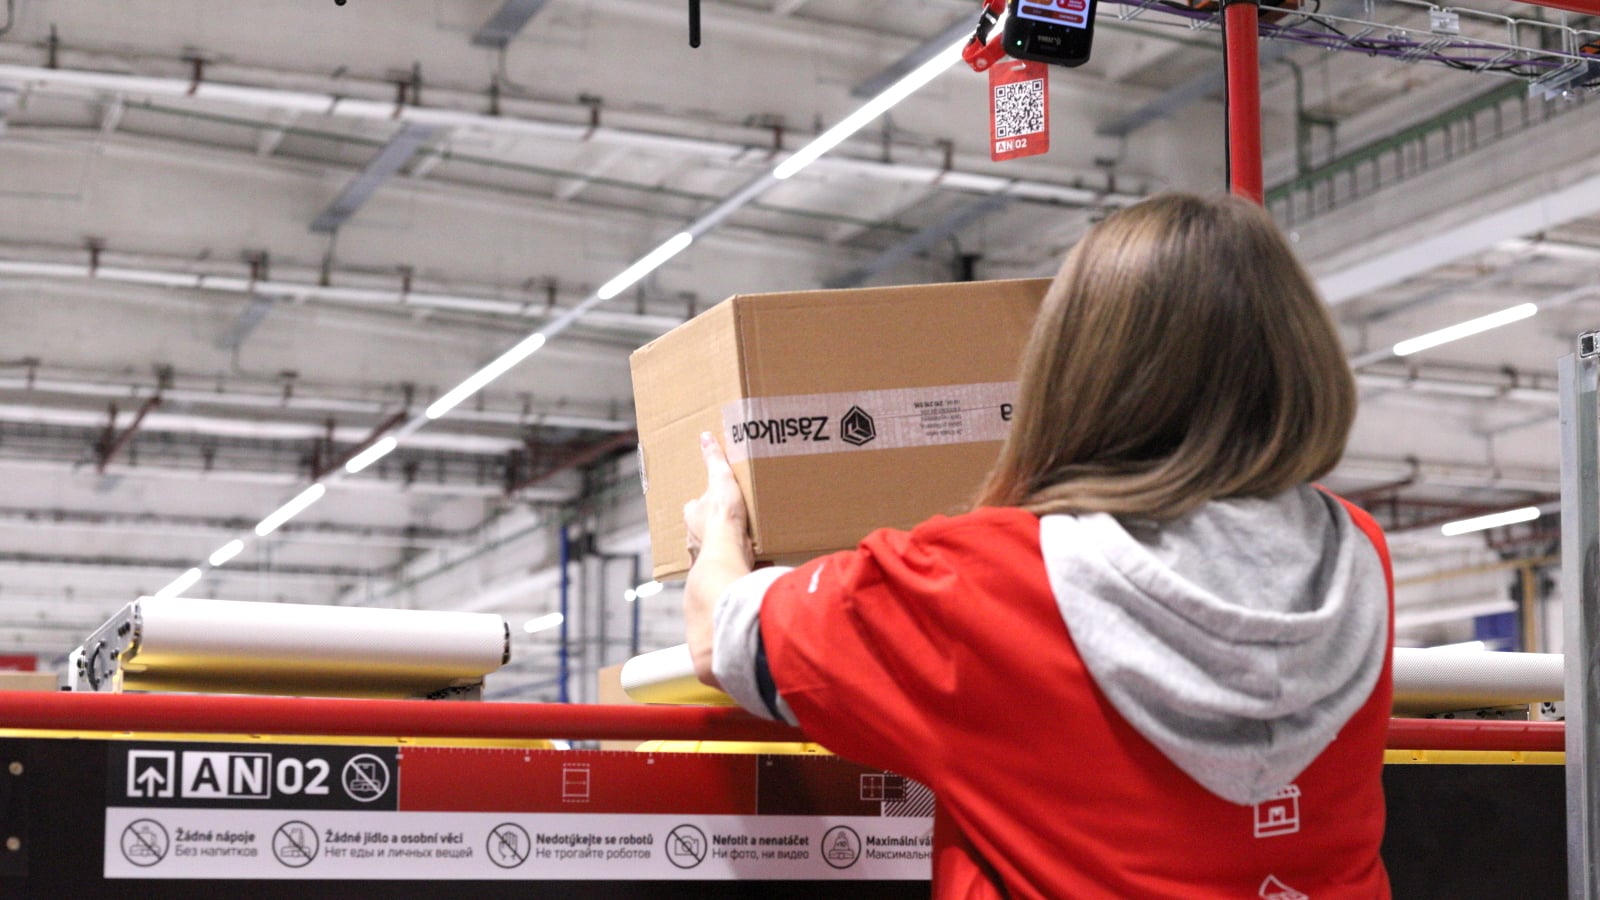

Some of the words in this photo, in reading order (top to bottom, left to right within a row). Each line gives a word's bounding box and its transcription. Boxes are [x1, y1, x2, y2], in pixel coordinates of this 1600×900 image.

[1015, 138, 1027, 149] 02
[732, 416, 830, 444] Zásilkovna
[191, 757, 265, 794] AN
[276, 758, 330, 794] 02
[175, 827, 213, 842] Žádné
[216, 830, 256, 844] nápoje
[325, 829, 361, 843] Žádné
[363, 833, 388, 845] jídlo
[391, 834, 397, 843] a
[401, 833, 438, 843] osobní
[440, 833, 463, 843] věci
[536, 833, 602, 847] Nedotýkejte
[619, 834, 653, 845] robotů
[750, 837, 757, 845] a
[759, 834, 809, 846] nenatáčet
[866, 835, 917, 847] Maximální
[175, 844, 197, 857] Без
[201, 847, 258, 857] напитков
[325, 847, 347, 857] Нет
[350, 849, 374, 859] еды
[377, 849, 384, 857] и
[387, 849, 431, 857] личных
[435, 848, 473, 859] вещей
[536, 848, 551, 858] Не
[555, 848, 603, 860] трогайте
[606, 848, 651, 860] роботов
[712, 848, 727, 858] Ни
[730, 848, 759, 861] фото,
[777, 850, 809, 860] видео
[866, 848, 932, 859] Максимальн
